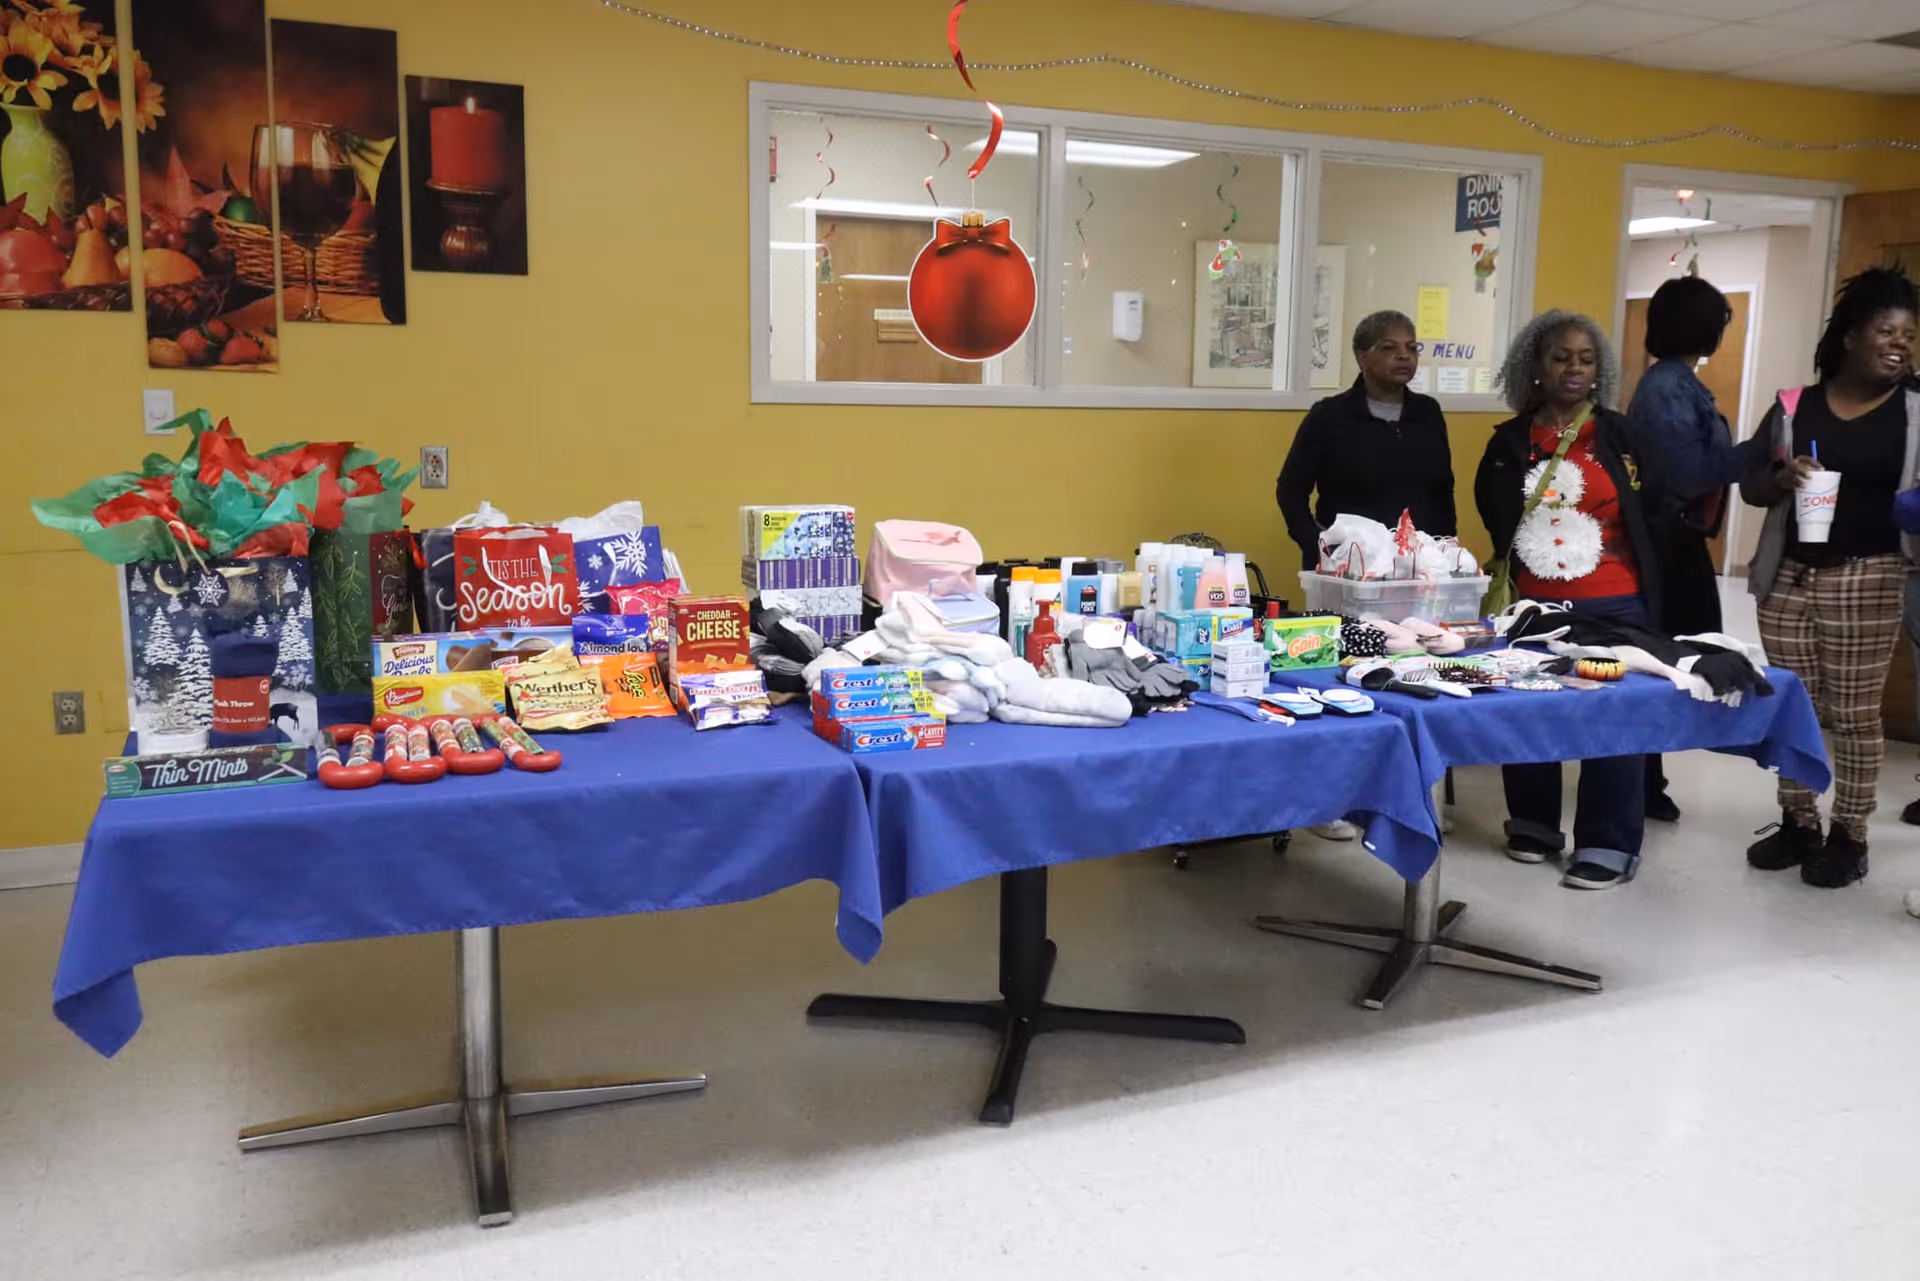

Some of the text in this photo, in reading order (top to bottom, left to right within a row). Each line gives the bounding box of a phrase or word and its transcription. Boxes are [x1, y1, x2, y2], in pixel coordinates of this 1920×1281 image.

[1466, 175, 1503, 196] DININ
[1467, 196, 1501, 219] ROO
[1432, 343, 1475, 359] MENU
[763, 514, 770, 526] 8
[510, 557, 539, 579] THE
[460, 581, 573, 623] Season
[1209, 592, 1224, 601] VO5
[697, 610, 731, 620] CHEDDAR
[686, 620, 740, 641] CHEESE
[1222, 621, 1244, 633] Coast
[580, 643, 625, 653] Almond
[1288, 634, 1321, 658] Gain
[384, 655, 434, 674] Delicious
[514, 677, 598, 695] Werther's
[832, 679, 872, 689] Crest
[837, 699, 876, 710] Crest
[857, 734, 899, 746] Crest
[924, 727, 945, 737] CAVITY
[144, 758, 190, 788] Thin
[187, 757, 249, 784] Mints
